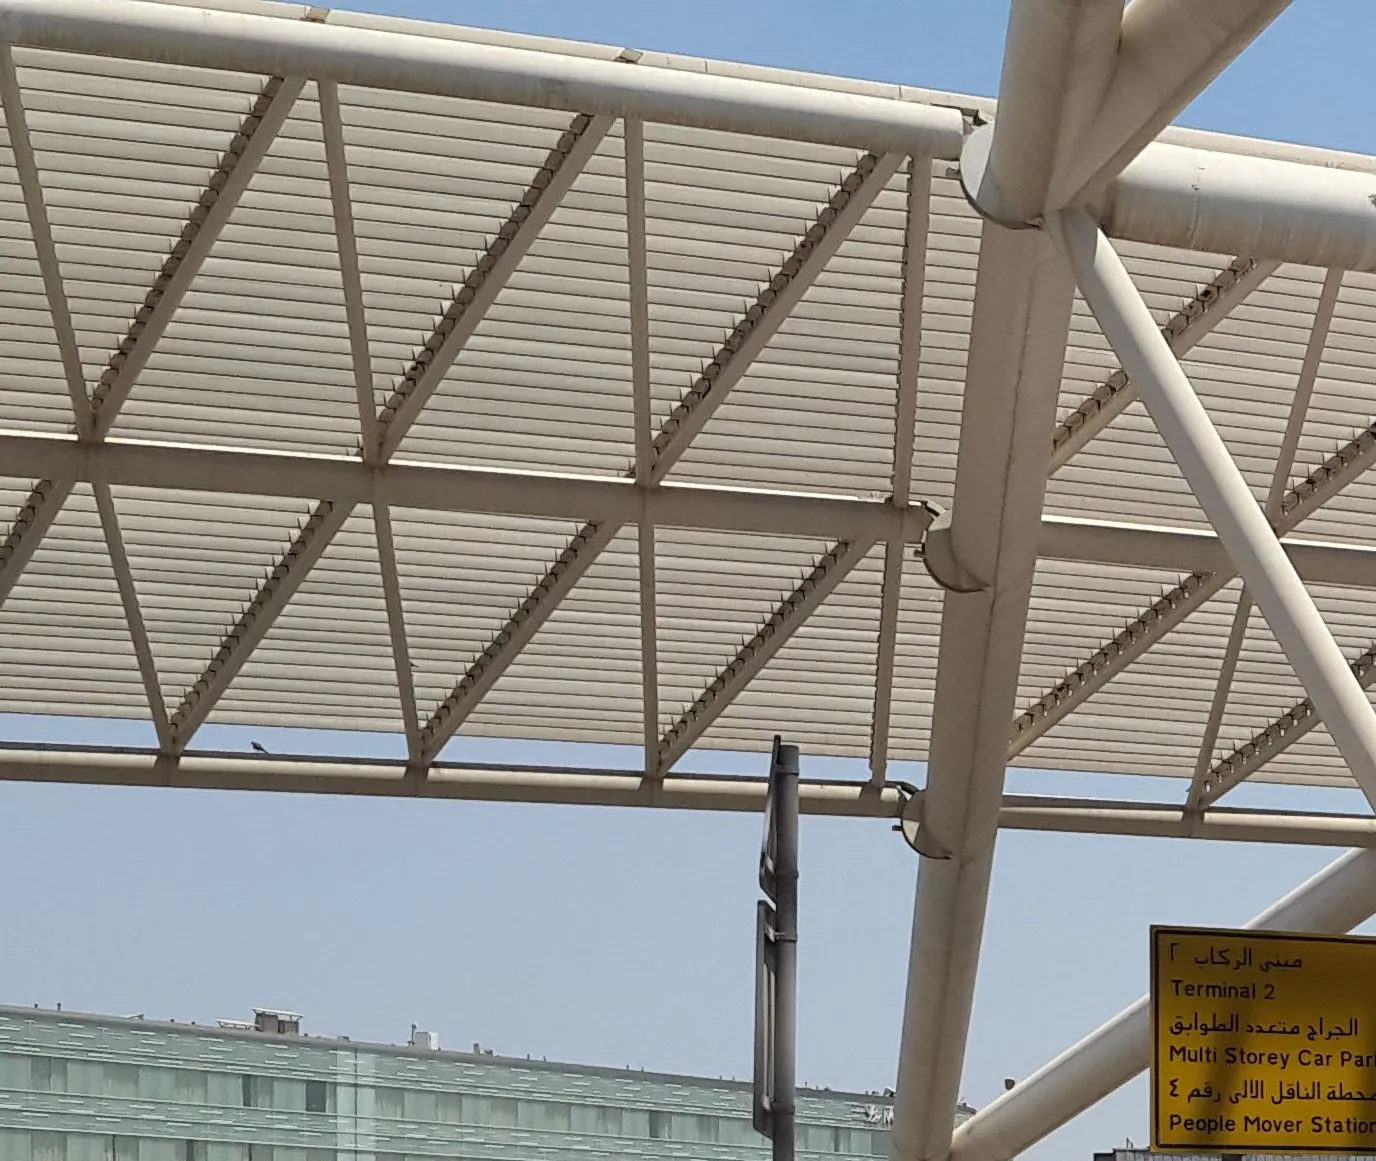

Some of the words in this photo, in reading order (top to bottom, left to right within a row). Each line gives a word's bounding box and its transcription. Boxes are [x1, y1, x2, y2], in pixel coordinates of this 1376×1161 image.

[1194, 946, 1253, 971] الركاب
[1171, 979, 1256, 999] Terminal
[1264, 984, 1276, 1000] 2
[1169, 1012, 1240, 1037] الطوابق
[1246, 1020, 1301, 1035] متعدد
[1307, 1016, 1358, 1041] الجراج
[1169, 1045, 1217, 1064] Multi
[1225, 1047, 1290, 1069] Storey
[1298, 1050, 1333, 1067] Car
[1169, 1077, 1179, 1098] ٤
[1187, 1080, 1222, 1104] رقم
[1271, 1080, 1321, 1105] الناقل
[1169, 1114, 1236, 1135] People
[1244, 1116, 1303, 1133] Mover
